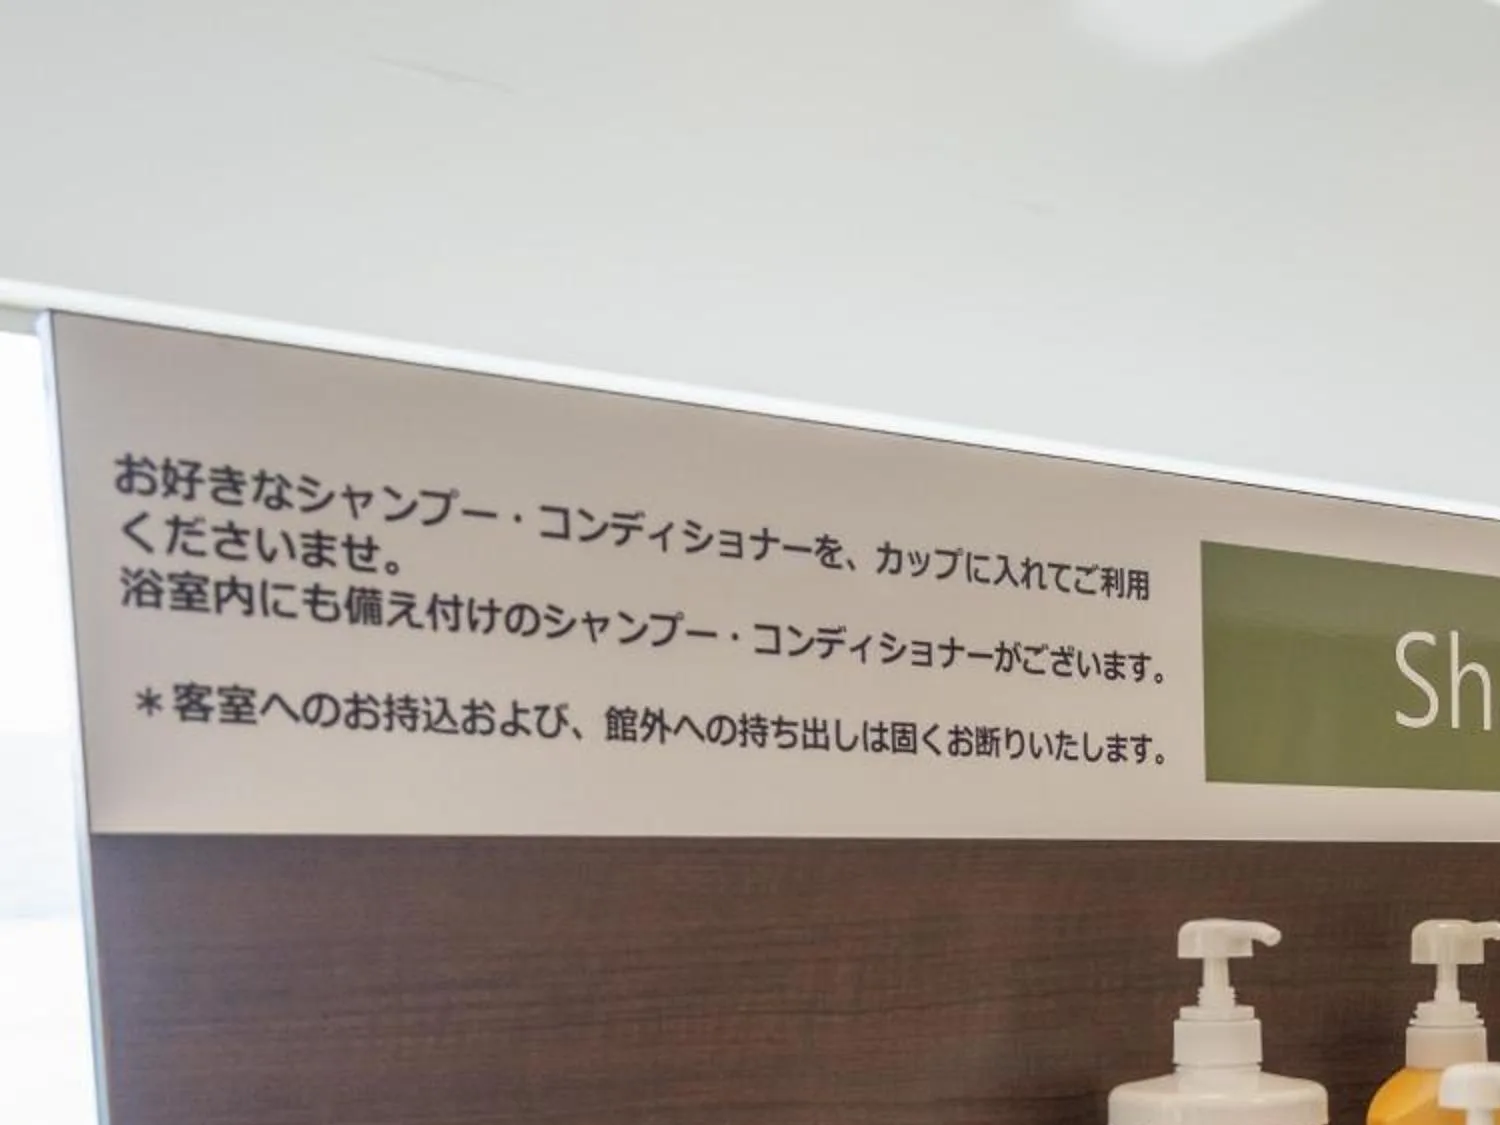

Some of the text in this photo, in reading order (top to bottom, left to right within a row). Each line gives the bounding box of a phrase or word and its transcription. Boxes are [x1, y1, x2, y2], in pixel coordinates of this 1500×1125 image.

[120, 511, 401, 577] くださいませ。
